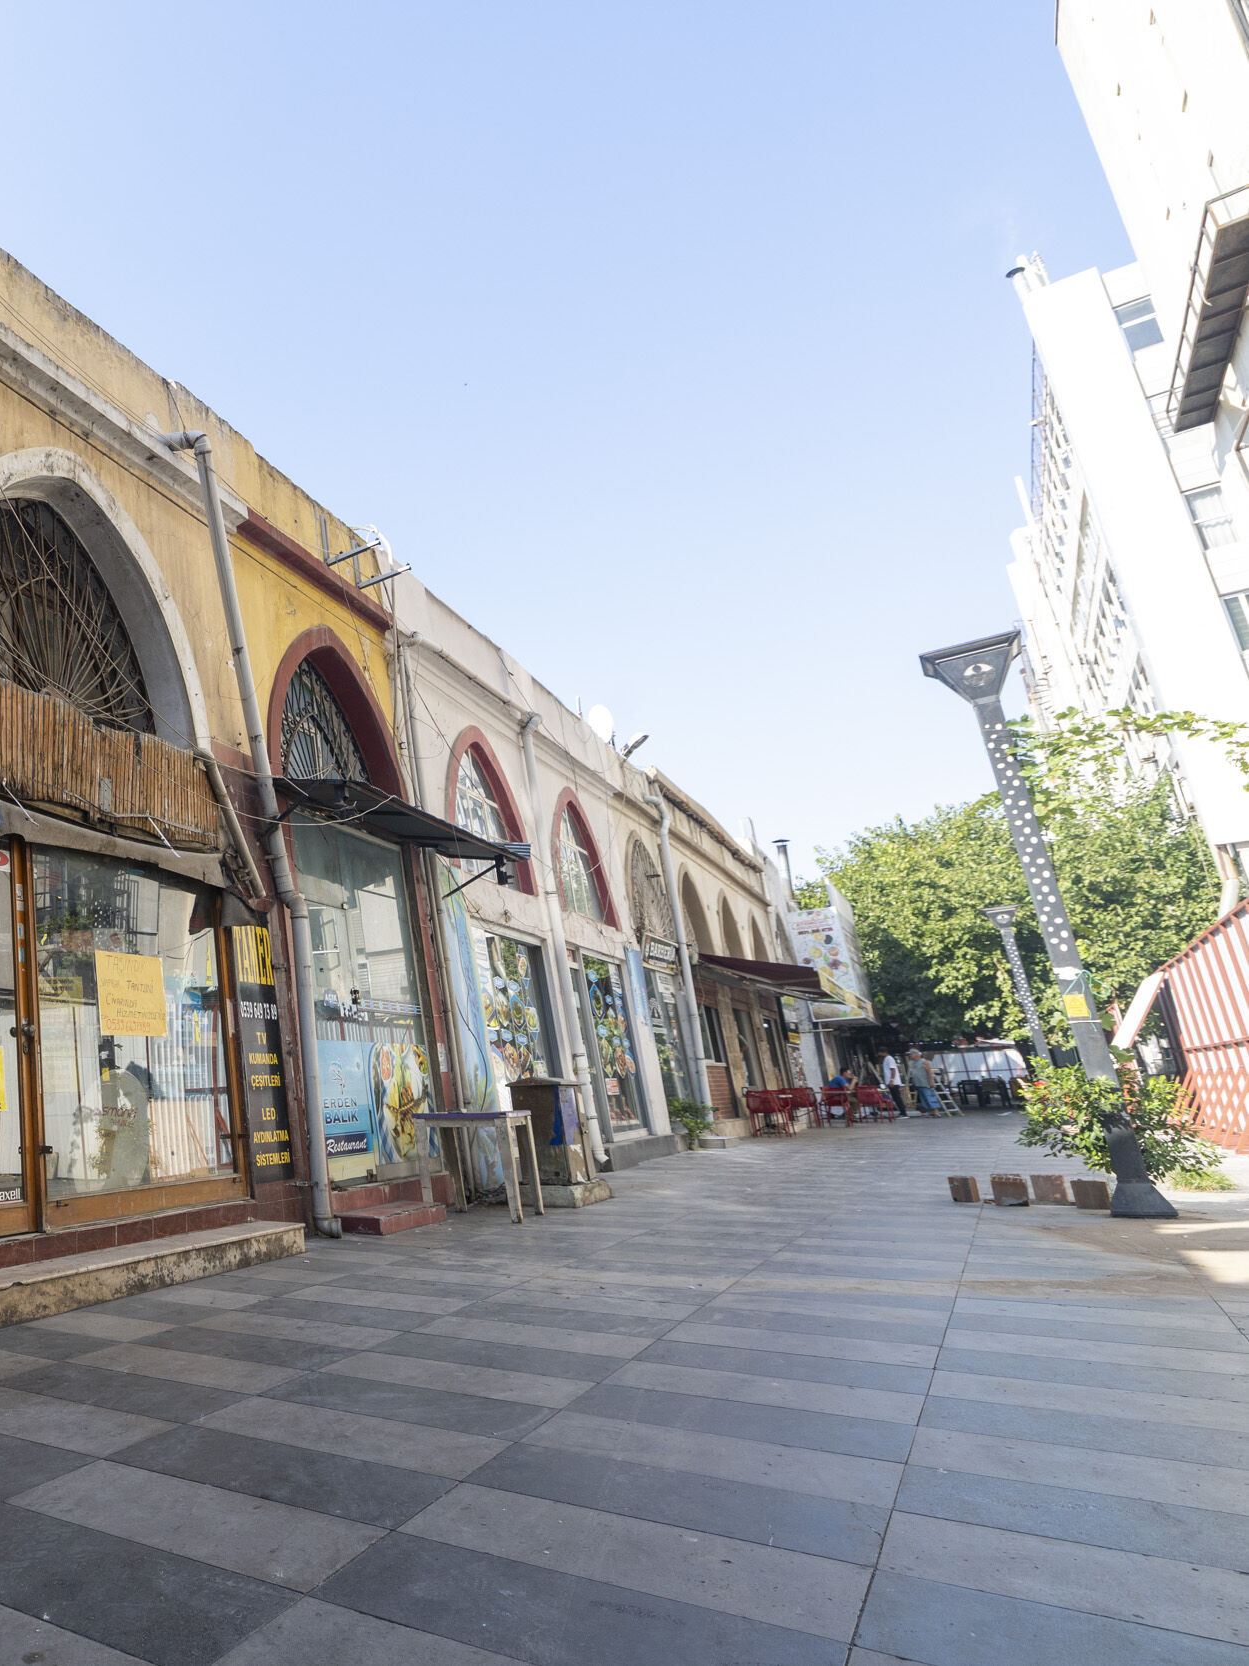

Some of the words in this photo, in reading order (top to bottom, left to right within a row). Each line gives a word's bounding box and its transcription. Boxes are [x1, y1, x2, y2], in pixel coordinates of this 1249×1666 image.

[234, 926, 275, 986] TAMER
[256, 1032, 267, 1045] TV
[248, 1053, 278, 1065] KUMANDA
[250, 1072, 281, 1090] ÇEŞİTLERİ
[323, 1097, 358, 1109] ERDEN
[261, 1107, 276, 1120] LED
[325, 1111, 359, 1125] BALIK
[253, 1129, 290, 1144] AYDINLATMA
[326, 1138, 367, 1154] Restaurant
[256, 1148, 291, 1167] SİSTEMLERİ
